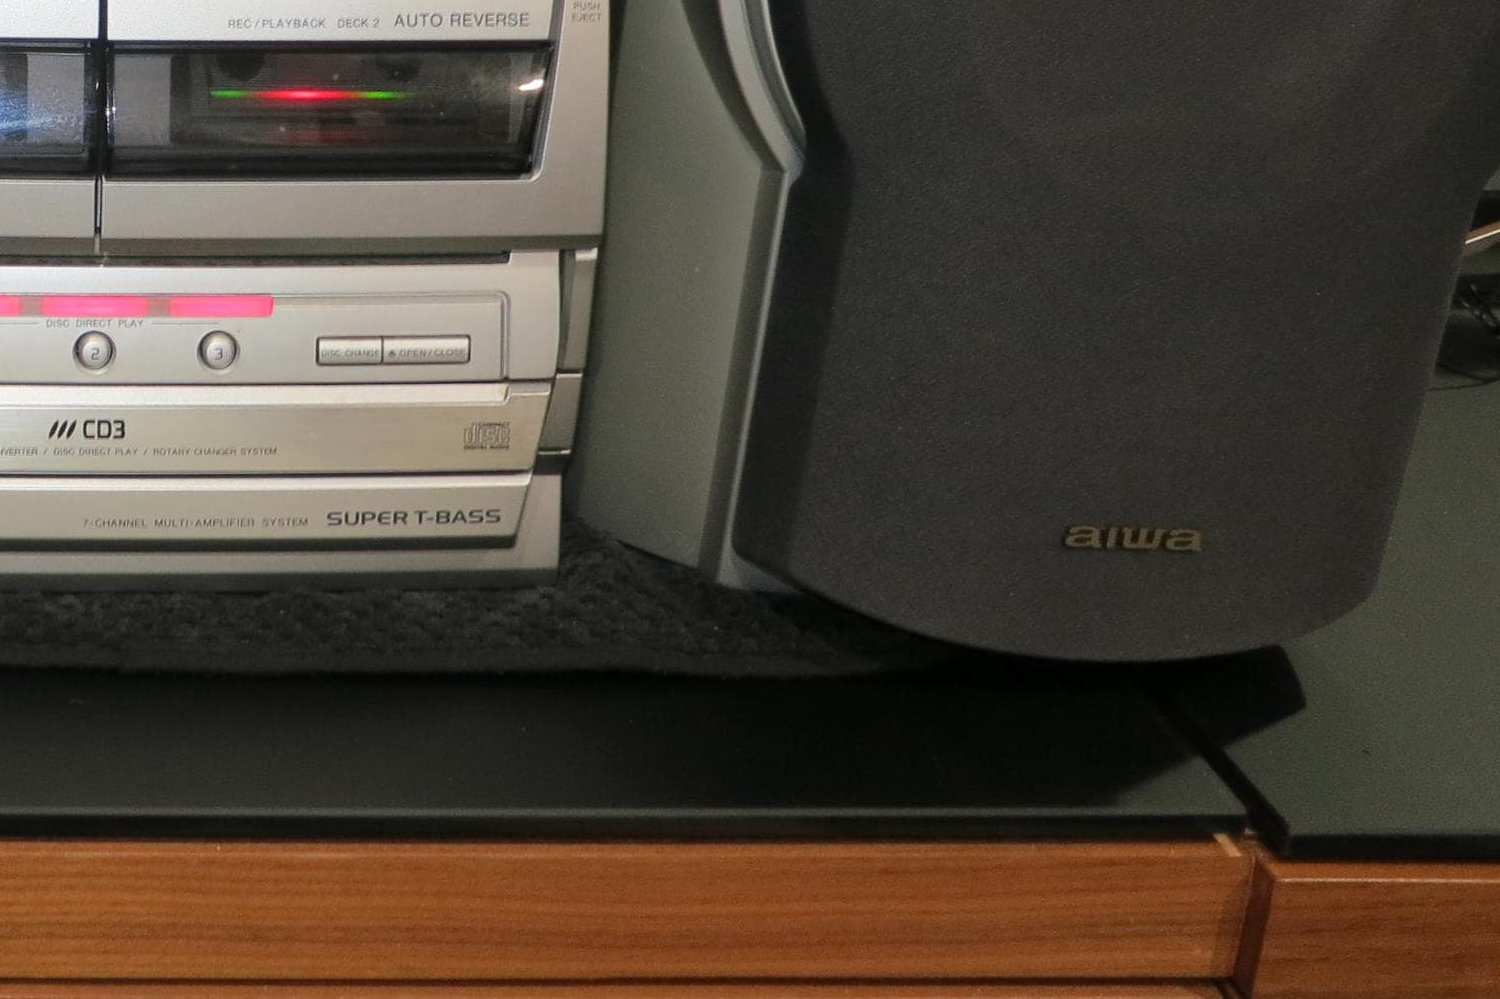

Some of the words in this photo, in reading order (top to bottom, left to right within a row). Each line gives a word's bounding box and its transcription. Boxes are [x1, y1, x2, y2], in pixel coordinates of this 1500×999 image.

[572, 2, 602, 11] PUSH
[337, 18, 368, 29] DECK
[372, 18, 381, 29] 2
[393, 13, 444, 29] AUTO
[449, 12, 531, 28] REVERSE
[45, 318, 71, 329] DISC
[75, 318, 113, 329] DIRECT
[117, 319, 145, 329] PLAY
[90, 347, 101, 361] 2
[213, 347, 224, 361] 3
[401, 348, 467, 359] OPEN/CLOSE
[82, 419, 126, 439] CD3
[53, 446, 76, 456] DISC
[78, 446, 110, 456] DIRECT
[114, 446, 139, 456] PLAY
[240, 446, 278, 456] SYSTEM
[82, 517, 148, 529] 7-CHANNEL
[153, 517, 256, 529] MULTI-AMPLIFIER
[261, 516, 309, 528] SYSTEM
[326, 510, 408, 527] SUPER
[413, 508, 502, 526] T-BASS
[1064, 524, 1204, 551] aiwa
